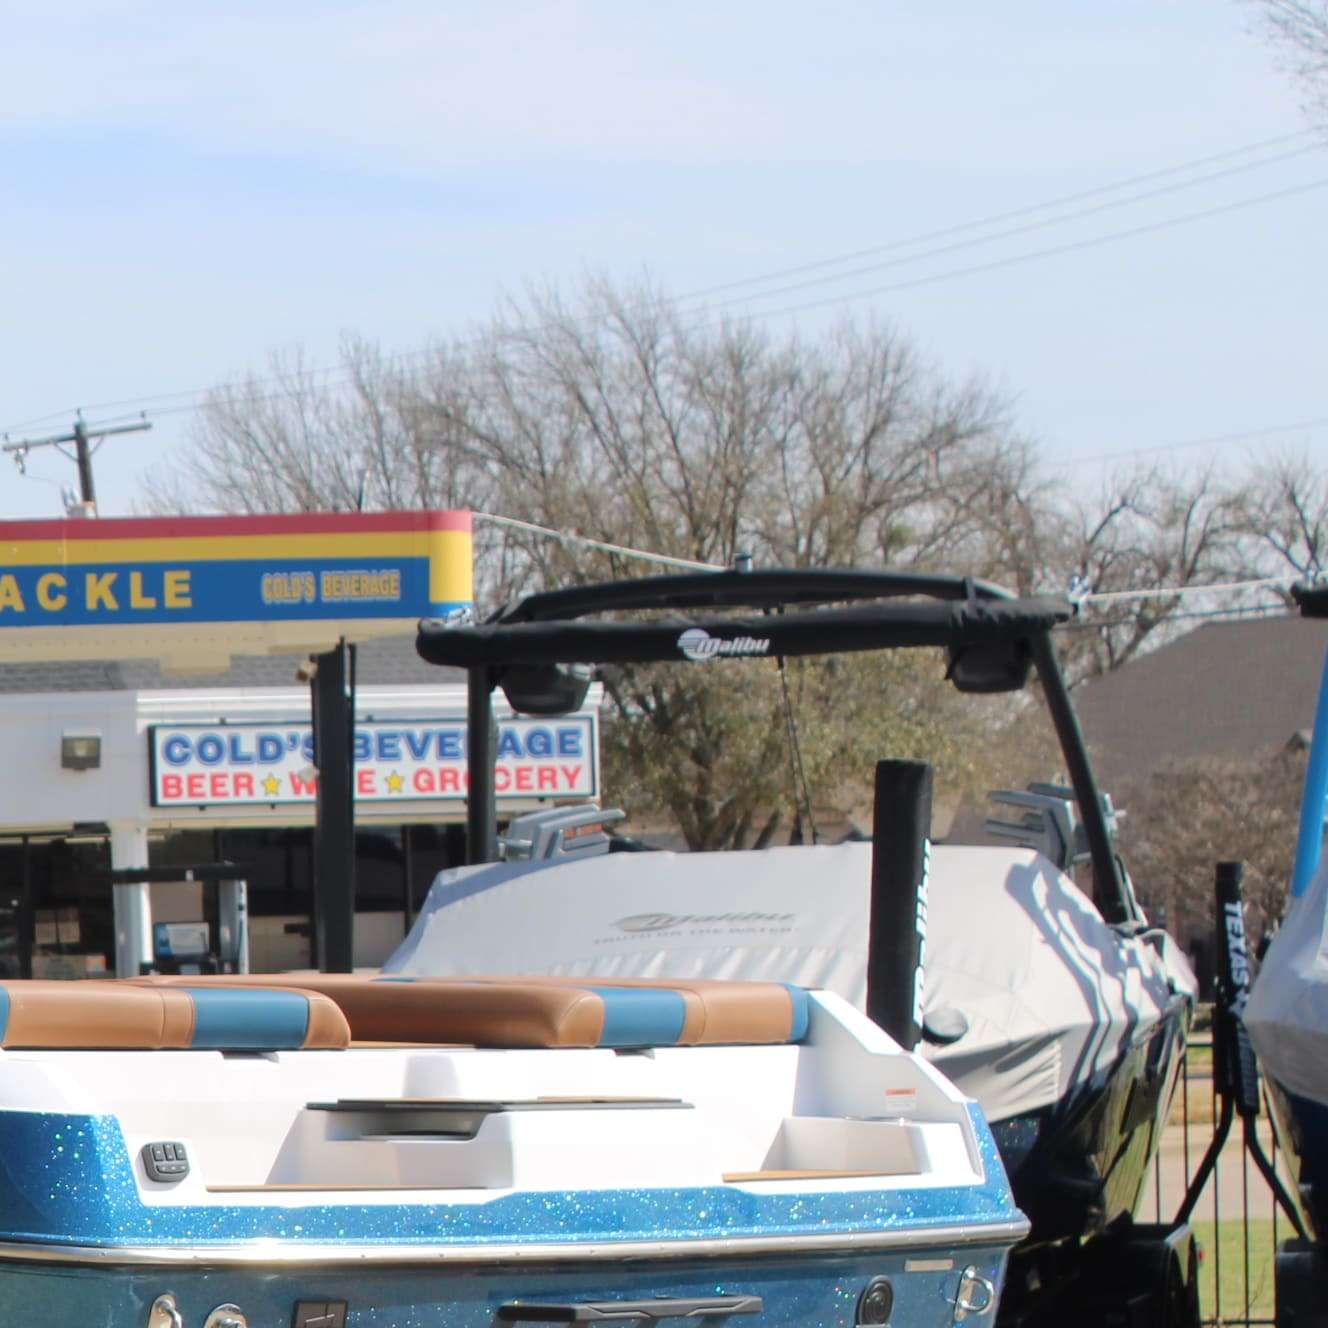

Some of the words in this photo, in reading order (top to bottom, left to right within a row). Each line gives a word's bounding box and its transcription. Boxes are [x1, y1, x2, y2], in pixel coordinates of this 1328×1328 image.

[262, 571, 316, 604] COLD'S
[320, 569, 401, 602] BEVERAGE
[354, 726, 583, 762] BEVEAGE
[161, 773, 255, 799] BEER
[289, 768, 376, 798] WE
[413, 764, 583, 794] GRCERY
[1224, 900, 1250, 987] TEXAS
